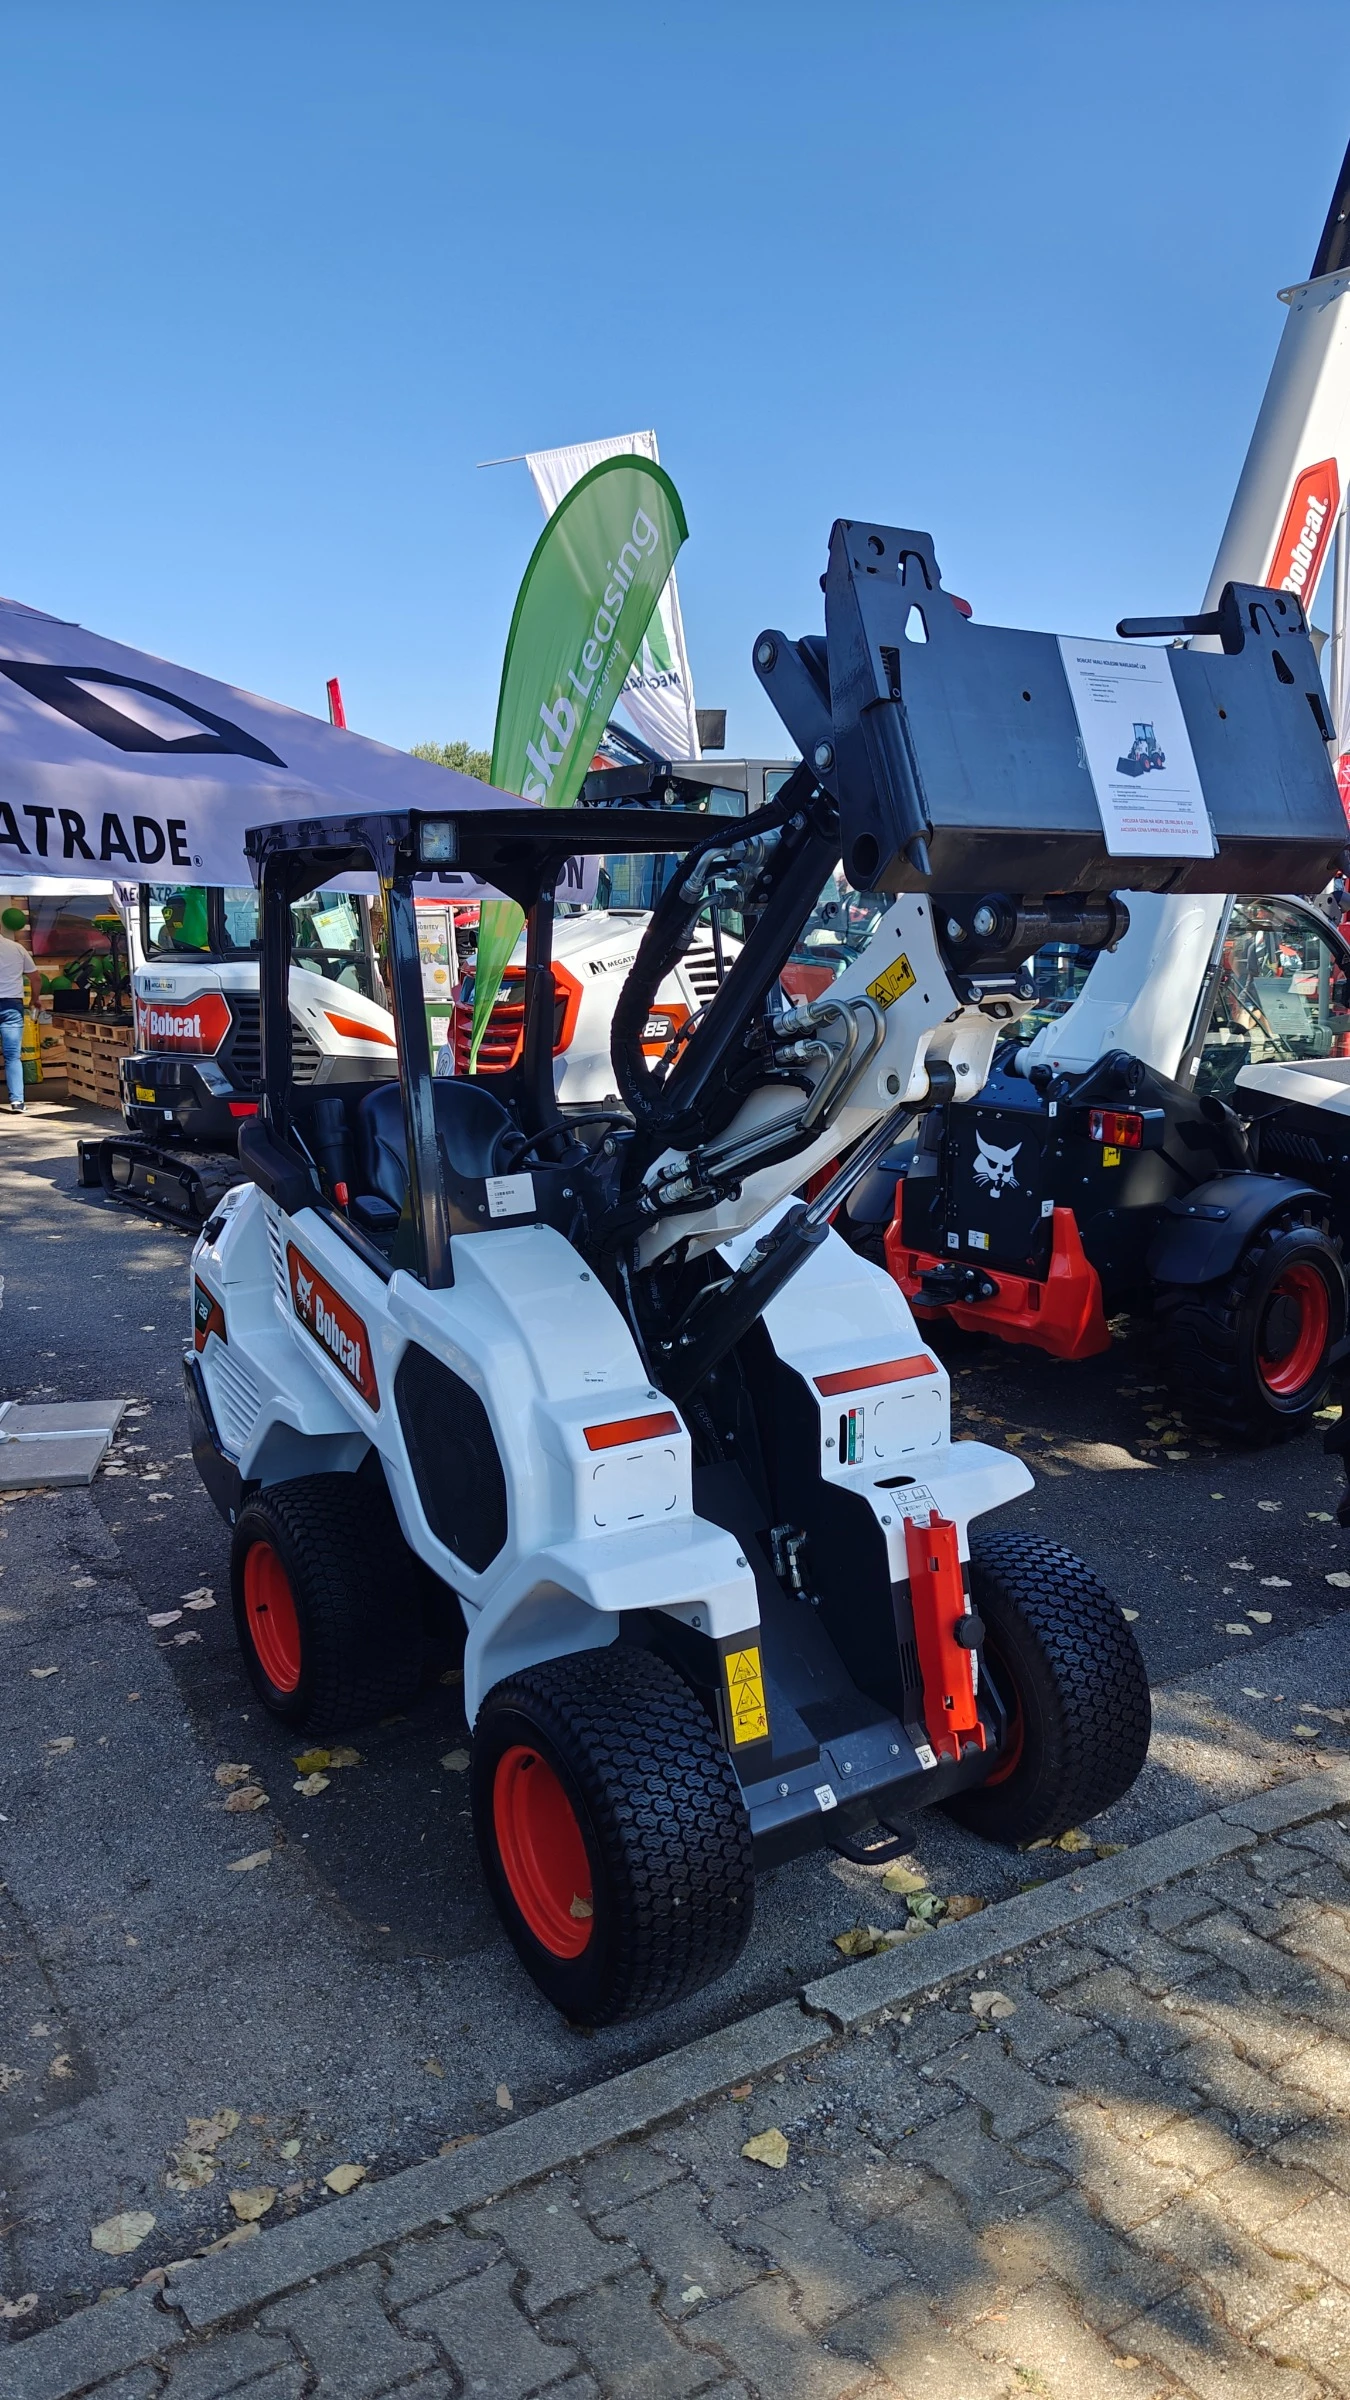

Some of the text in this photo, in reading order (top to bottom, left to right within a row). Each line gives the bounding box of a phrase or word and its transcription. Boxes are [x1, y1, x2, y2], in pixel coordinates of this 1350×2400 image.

[1280, 495, 1327, 596] Bobcat
[523, 507, 660, 806] skb Leasing
[602, 640, 621, 686] group
[150, 1011, 201, 1038] Bobcat
[643, 1021, 669, 1038] 85
[315, 1293, 362, 1382] Bobcat
